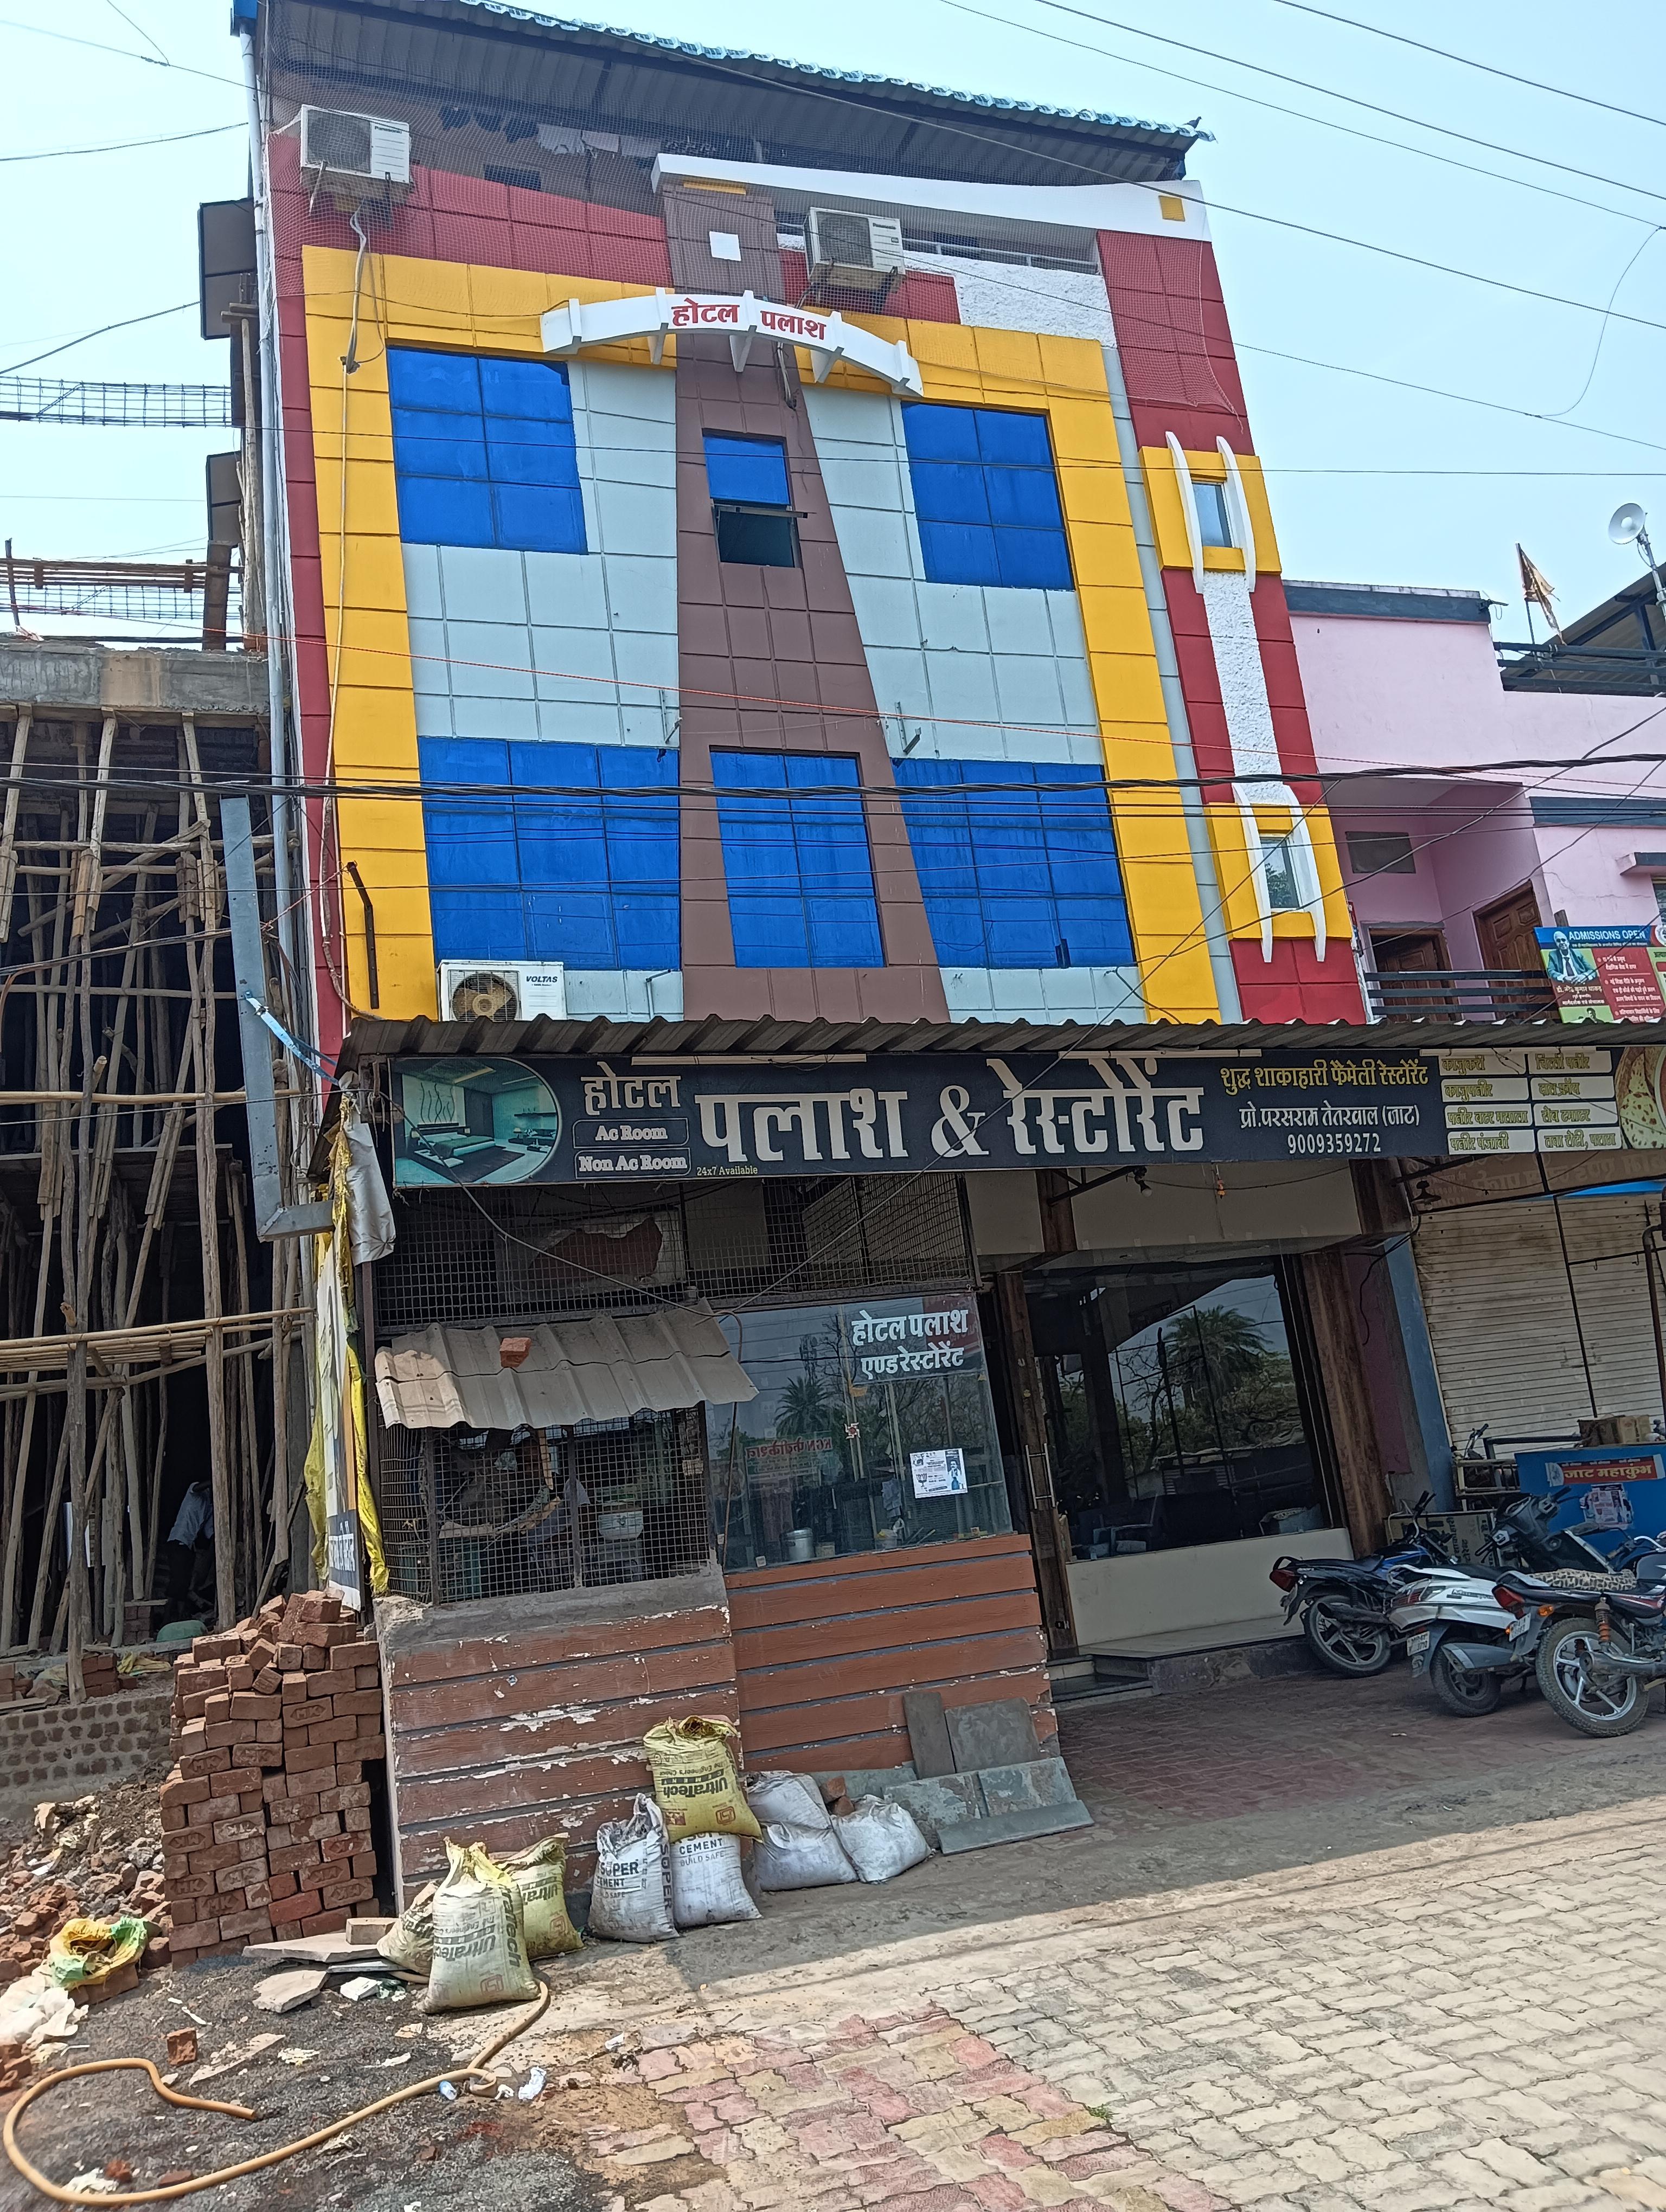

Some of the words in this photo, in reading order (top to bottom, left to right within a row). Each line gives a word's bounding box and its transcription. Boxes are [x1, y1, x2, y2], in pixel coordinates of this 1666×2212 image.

[671, 298, 739, 326] होटल
[760, 310, 826, 340] पलाश
[1569, 930, 1621, 941] ADMISSIONS
[1622, 930, 1646, 940] OPEN
[1566, 1052, 1590, 1069] पनीर
[1220, 1067, 1251, 1095] शुद्ध
[1254, 1059, 1328, 1089] शाकाहारी
[1330, 1059, 1376, 1085] फैमेली
[1377, 1058, 1428, 1085] रेस्टोरेंट
[581, 1061, 681, 1115] होटल
[1538, 1083, 1557, 1096] दाल
[695, 1088, 908, 1162] पलाश
[931, 1085, 989, 1158] &
[987, 1058, 1204, 1154] रेस्टोरेंट
[1321, 1100, 1377, 1126] तेतरवाल
[1383, 1104, 1420, 1127] (जाट)
[1447, 1107, 1473, 1125] पनीर
[1541, 1105, 1559, 1122] सेव
[595, 1126, 618, 1140] Ac
[620, 1125, 668, 1140] Room
[1287, 1133, 1381, 1154] 9009359272
[1450, 1133, 1476, 1150] पनीर
[1544, 1135, 1564, 1148] तवा
[579, 1156, 614, 1171] Non
[616, 1156, 638, 1171] Ac
[640, 1155, 687, 1169] Room
[696, 1166, 718, 1176] 24x7
[719, 1165, 758, 1175] Available
[851, 1310, 906, 1346] होटल
[908, 1309, 969, 1337] पलाश
[861, 1354, 899, 1380] एण्ड
[898, 1341, 964, 1372] रेस्टोरेंट
[1564, 1469, 1594, 1478] जाट
[1597, 1463, 1652, 1479] महाकुंभ
[663, 1777, 728, 1798] UltraTech
[679, 1838, 723, 1855] CEMENT
[680, 1856, 703, 1867] BUILD
[705, 1850, 725, 1861] SAFE
[600, 1861, 640, 1877] SUPER
[660, 1844, 672, 1911] SUPER
